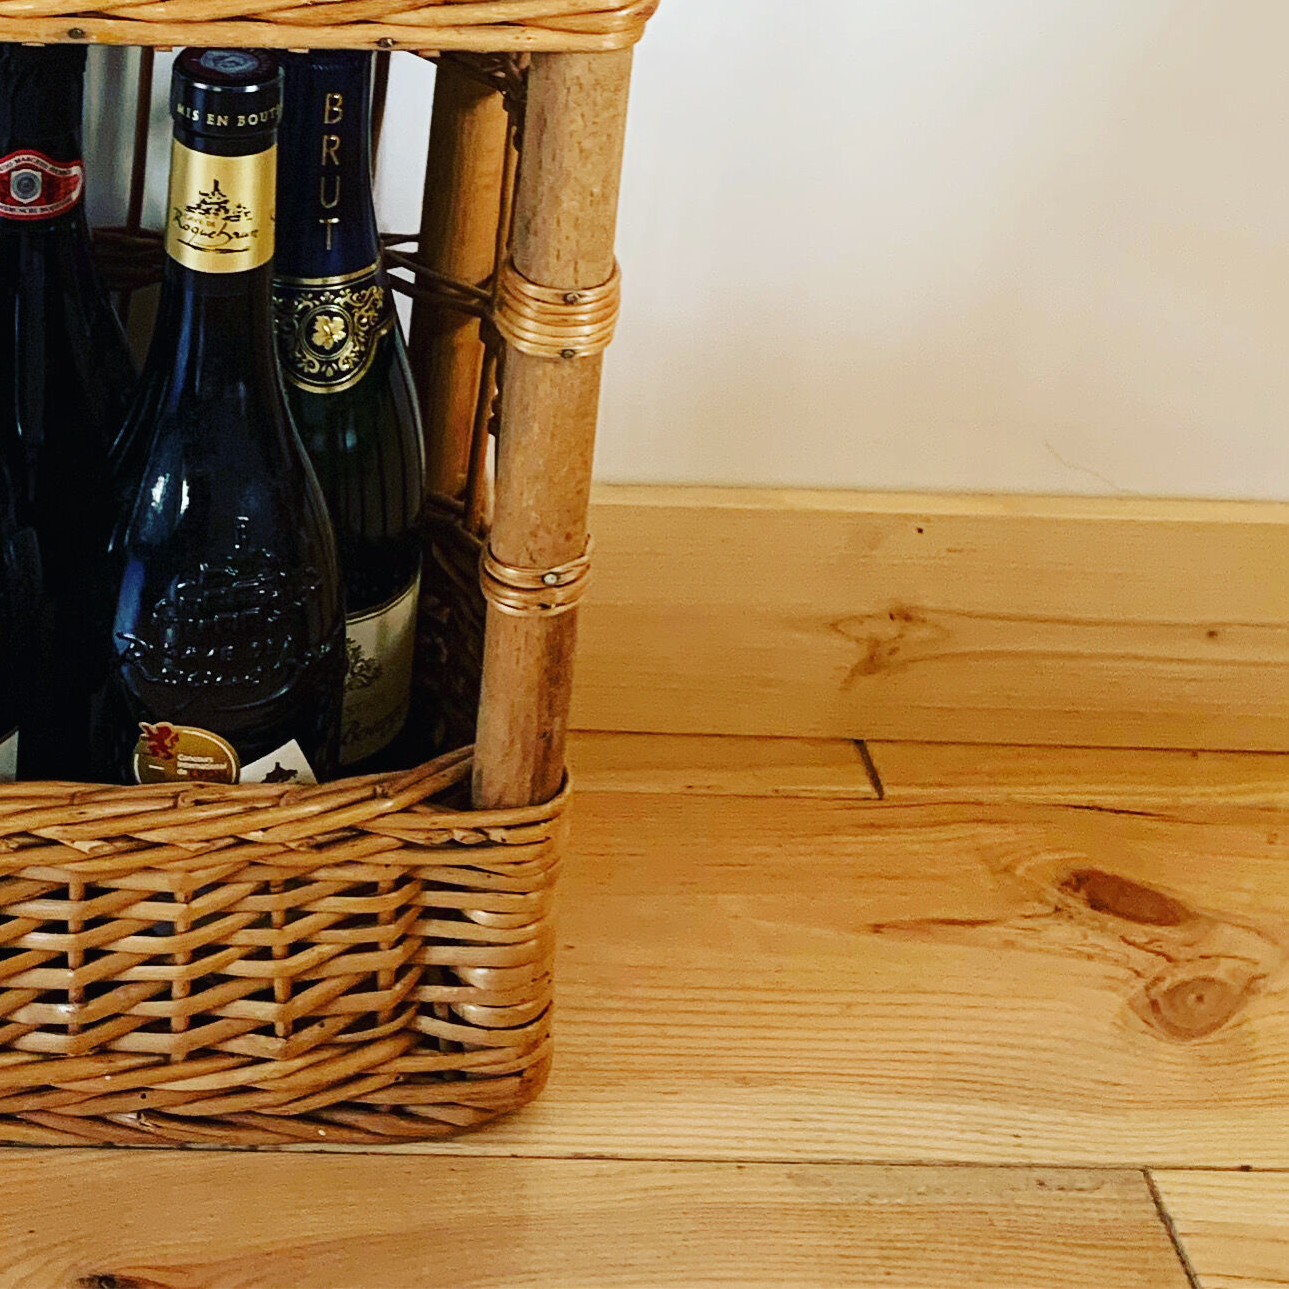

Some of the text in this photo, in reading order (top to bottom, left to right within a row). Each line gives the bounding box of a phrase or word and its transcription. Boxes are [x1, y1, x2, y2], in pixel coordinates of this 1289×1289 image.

[177, 103, 200, 121] MIS
[206, 113, 229, 126] EN
[319, 92, 343, 250] BRUT
